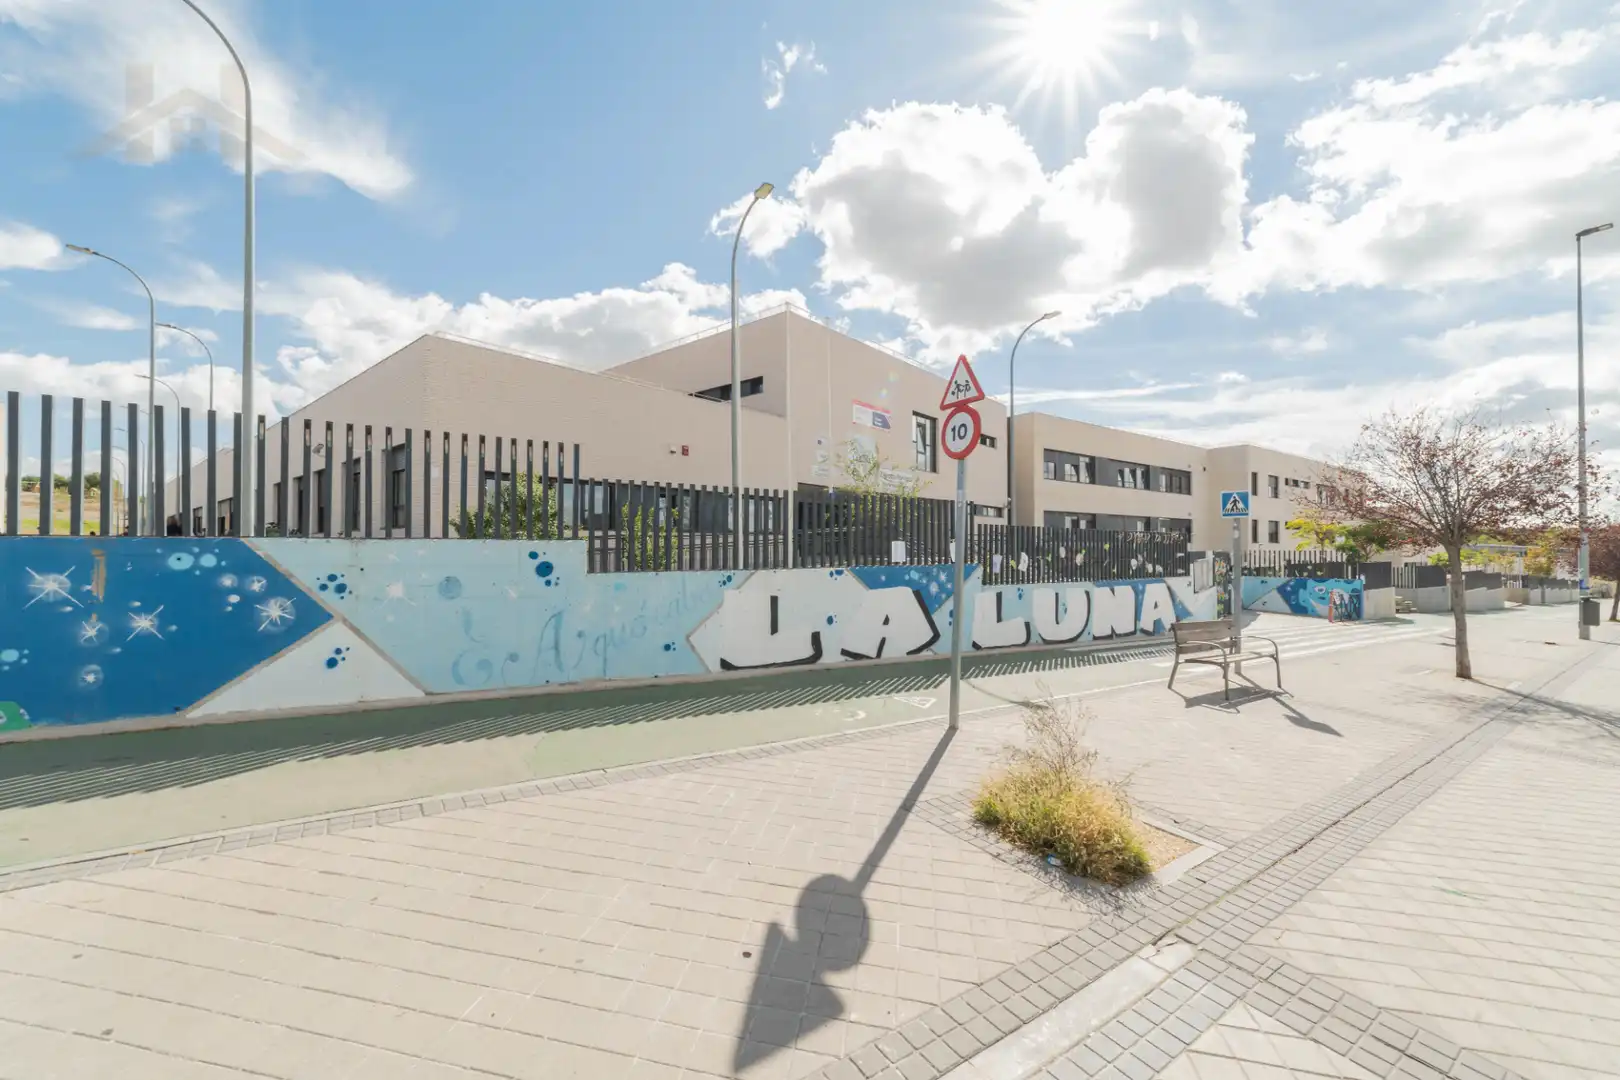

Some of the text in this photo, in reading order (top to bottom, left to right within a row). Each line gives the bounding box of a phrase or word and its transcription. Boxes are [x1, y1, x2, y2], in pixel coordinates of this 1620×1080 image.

[950, 423, 969, 442] 10
[720, 586, 941, 670] LA
[971, 579, 1178, 651] LUNA
